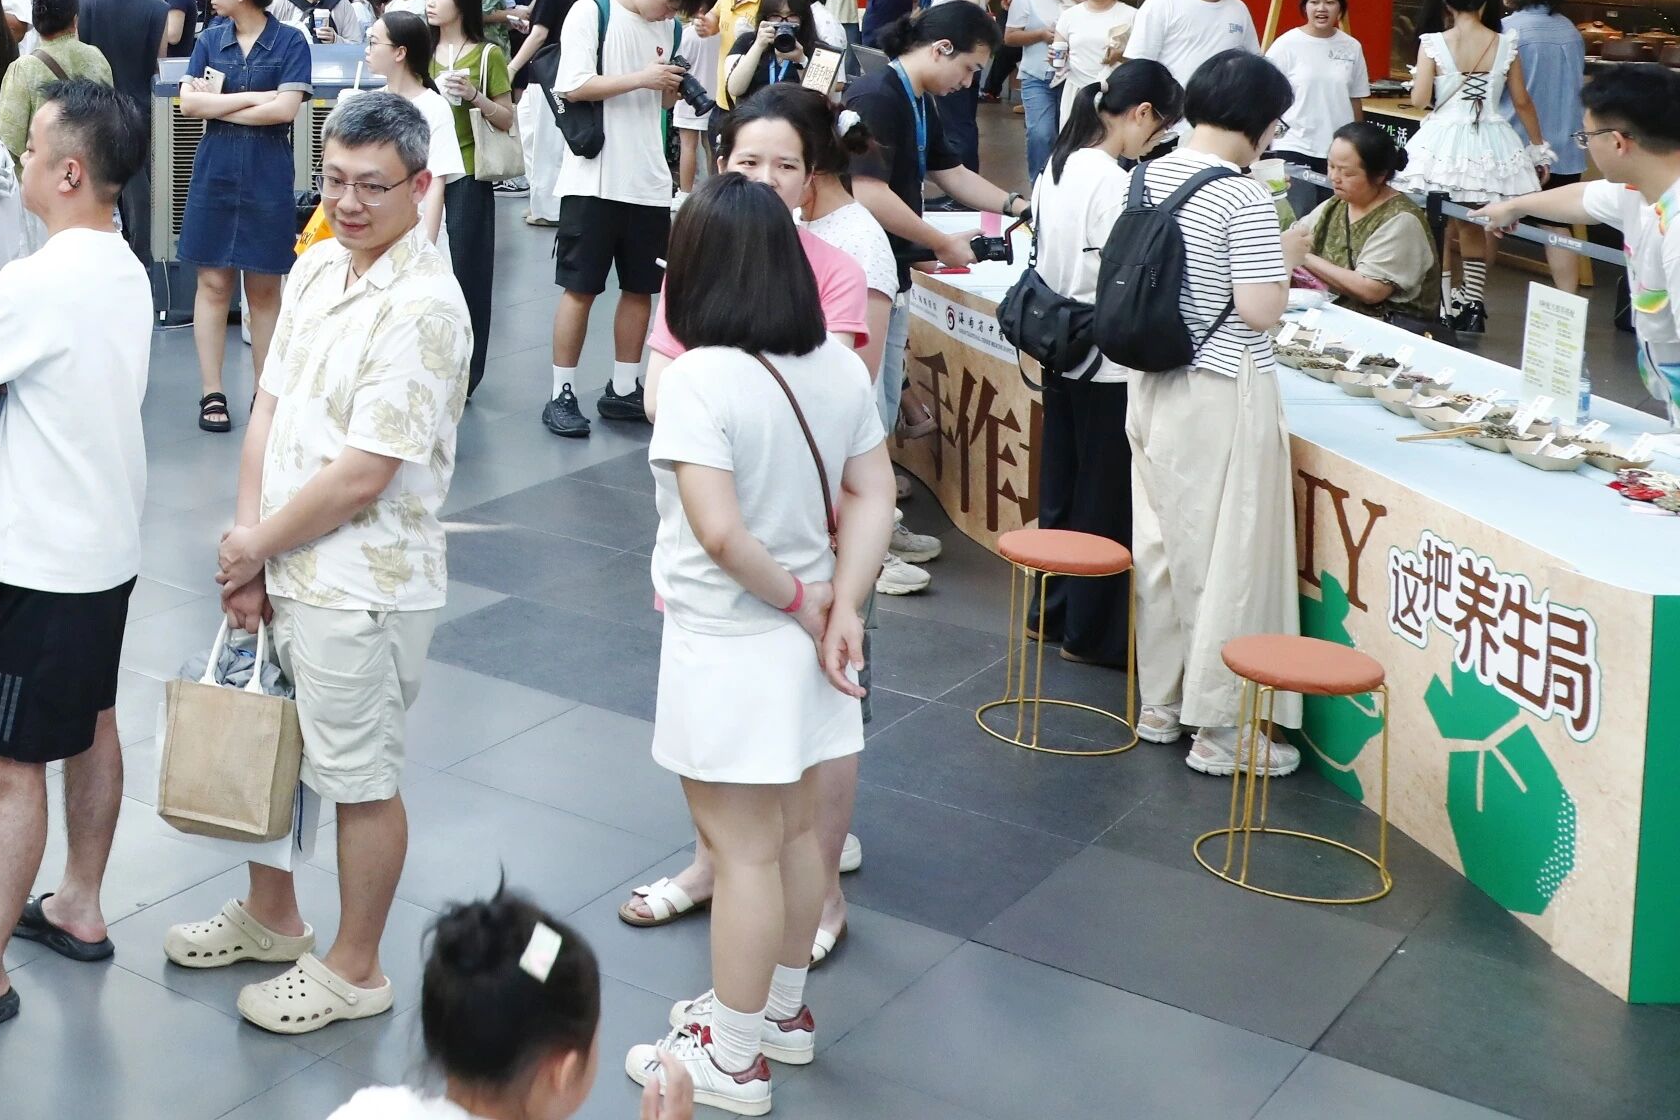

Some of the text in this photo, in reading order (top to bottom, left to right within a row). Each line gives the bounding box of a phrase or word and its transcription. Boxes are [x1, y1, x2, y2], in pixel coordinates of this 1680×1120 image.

[914, 352, 1043, 532] 手作
[1297, 468, 1387, 612] IY
[1390, 537, 1595, 734] 这把养生局
